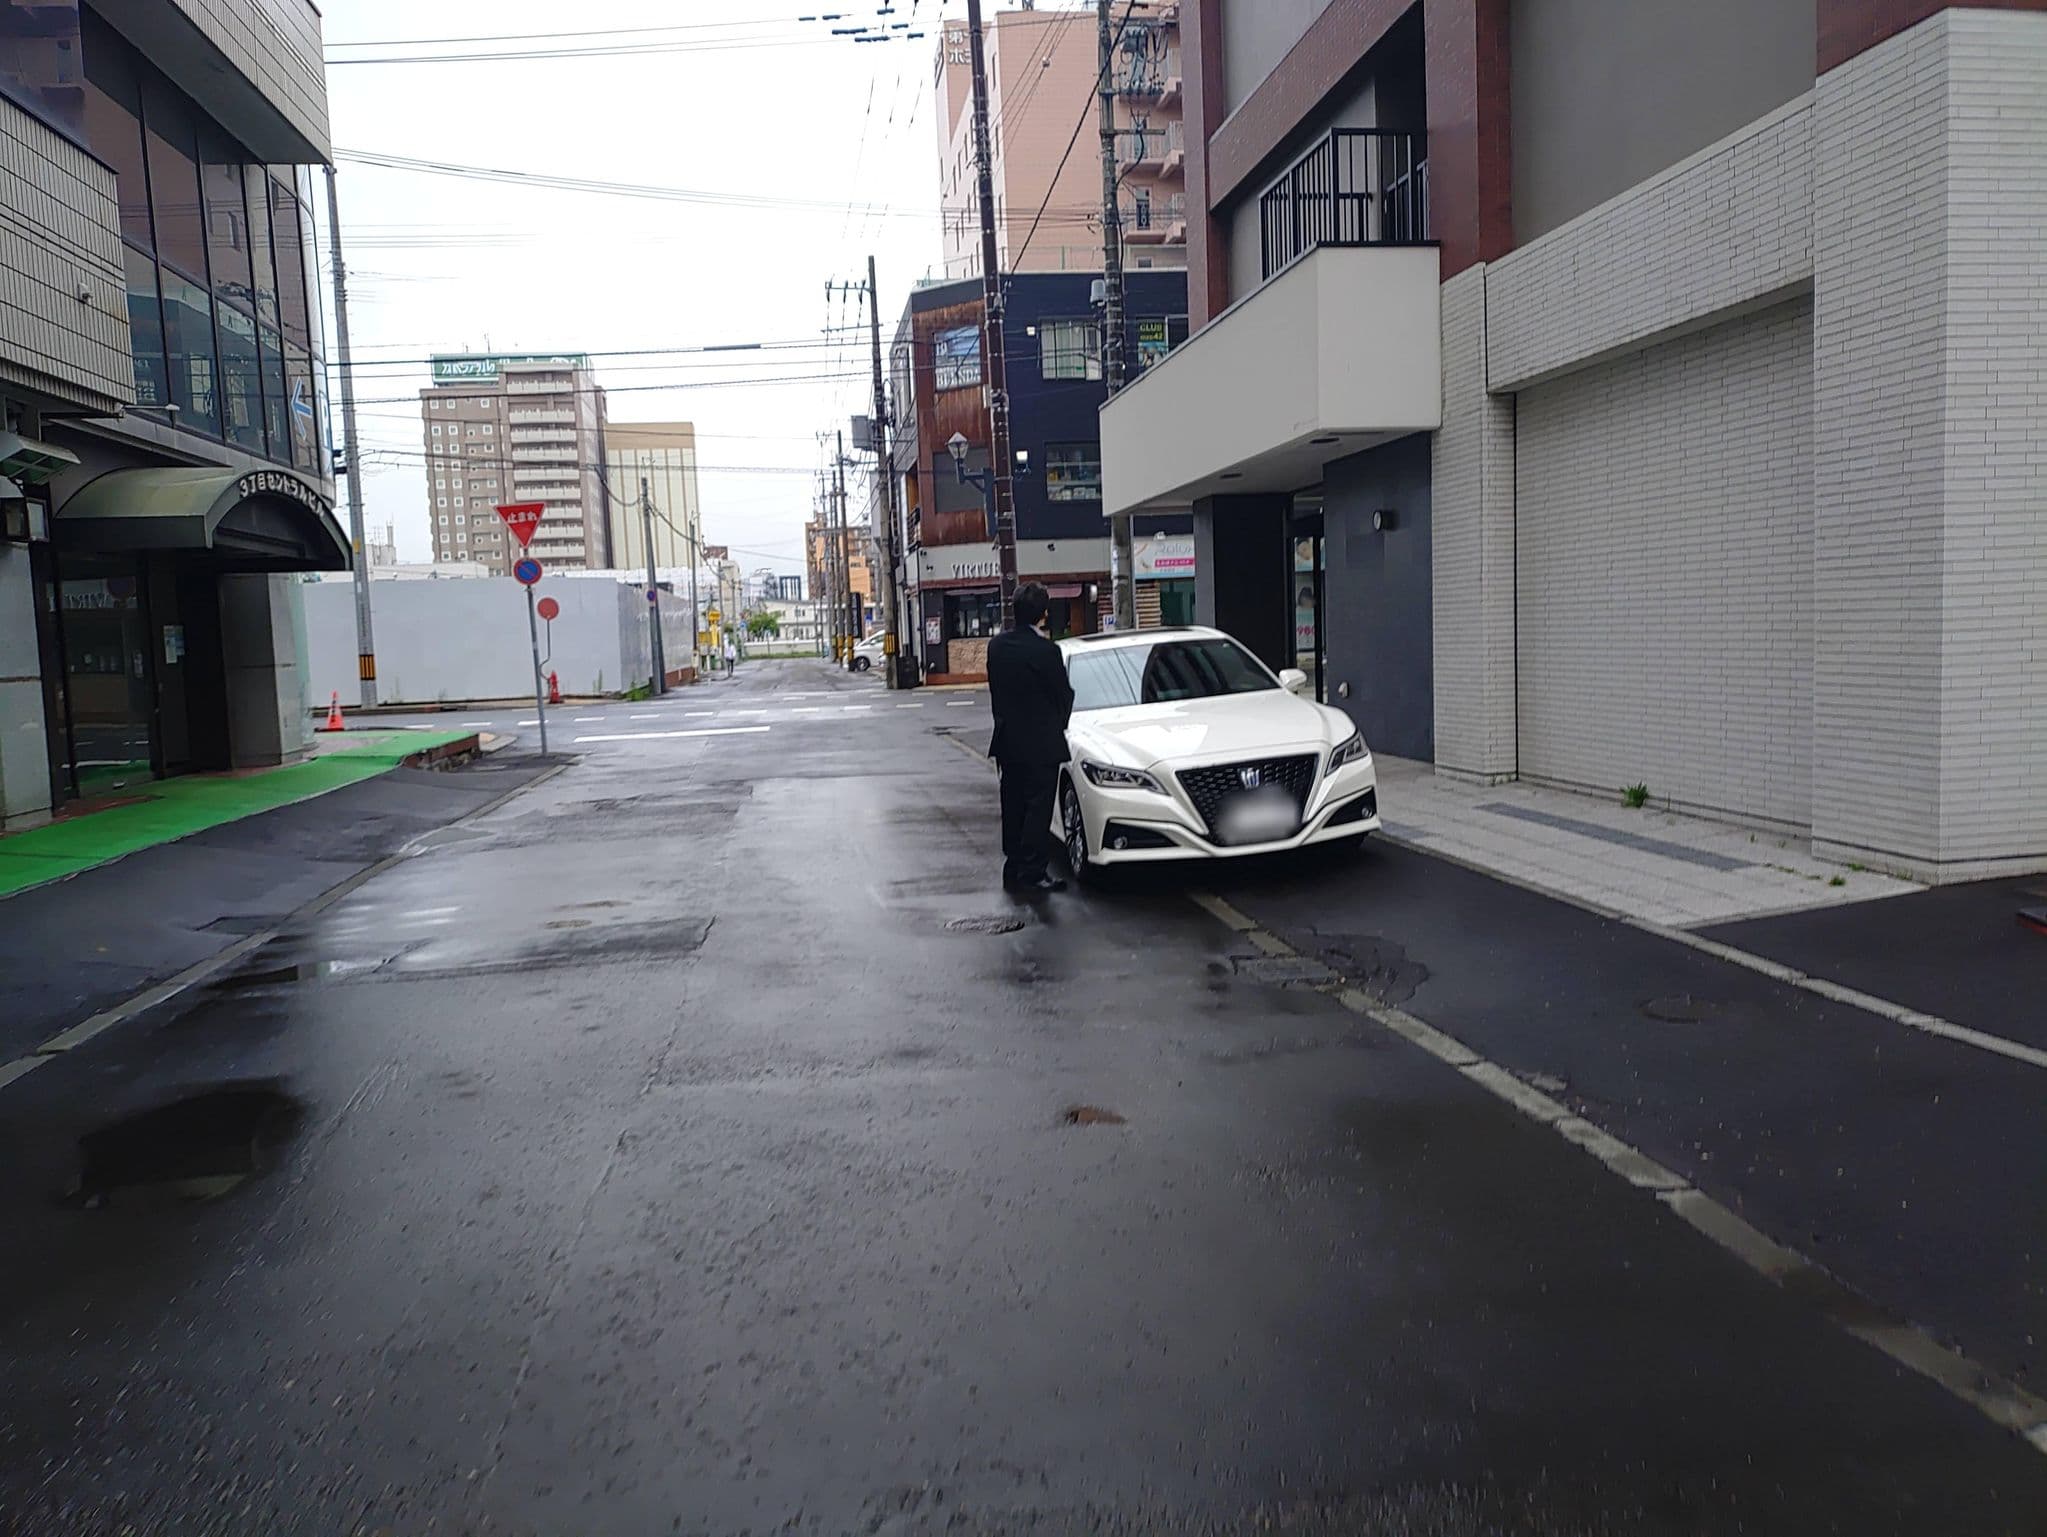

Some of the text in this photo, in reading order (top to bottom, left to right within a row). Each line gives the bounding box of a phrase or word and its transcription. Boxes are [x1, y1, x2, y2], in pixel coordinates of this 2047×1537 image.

[240, 473, 324, 517] 3丁目セントラルビル
[508, 511, 537, 523] 止まれ
[951, 562, 1001, 578] VIRTUE
